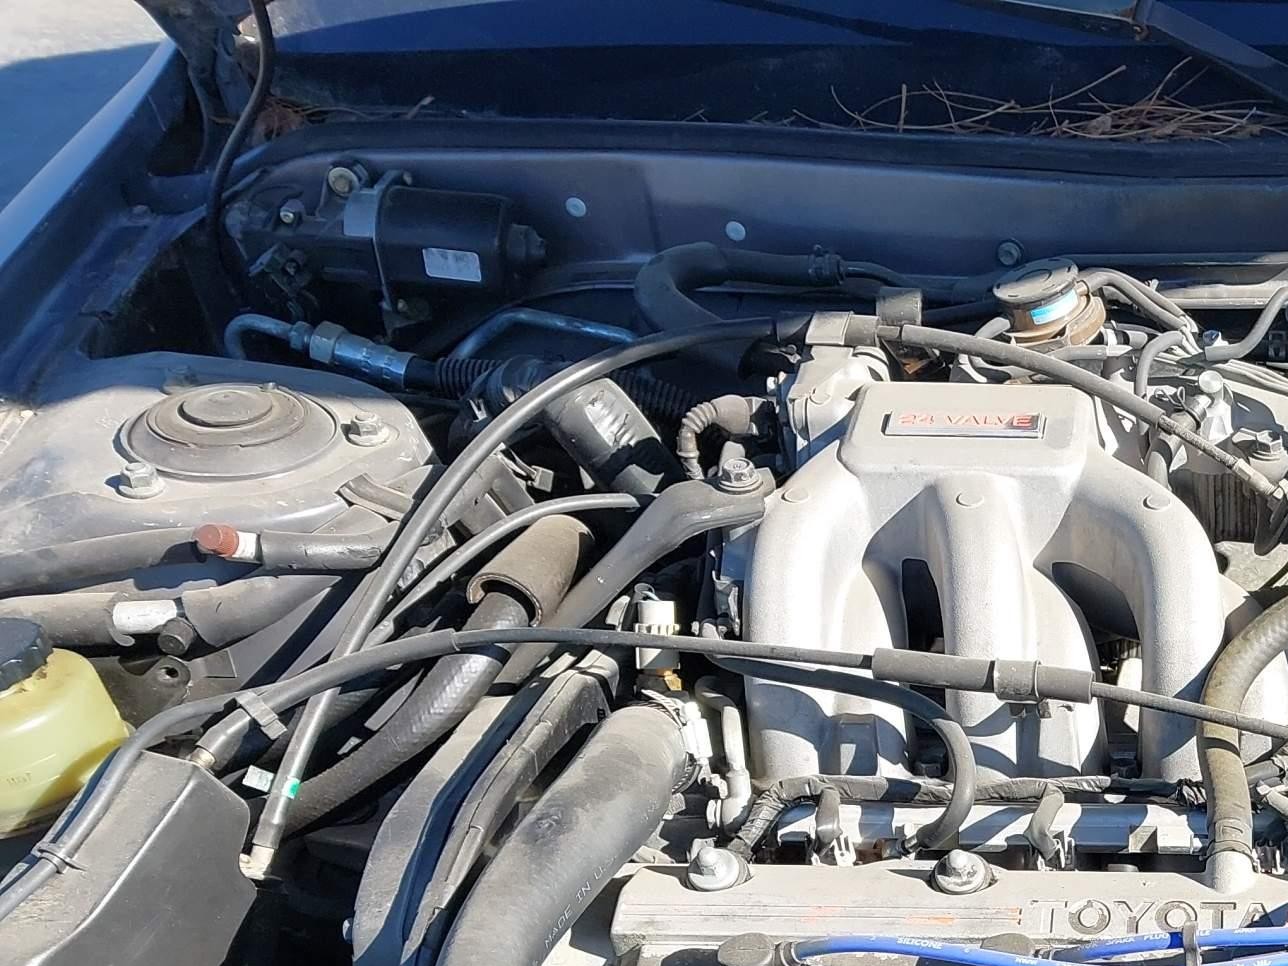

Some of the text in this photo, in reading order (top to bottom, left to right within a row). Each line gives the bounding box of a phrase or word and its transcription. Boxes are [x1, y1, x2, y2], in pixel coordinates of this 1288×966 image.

[898, 412, 1033, 428] 24 VALVE
[575, 880, 593, 904] IN
[1030, 899, 1275, 935] TOYOTA
[896, 936, 943, 950] SILICONE
